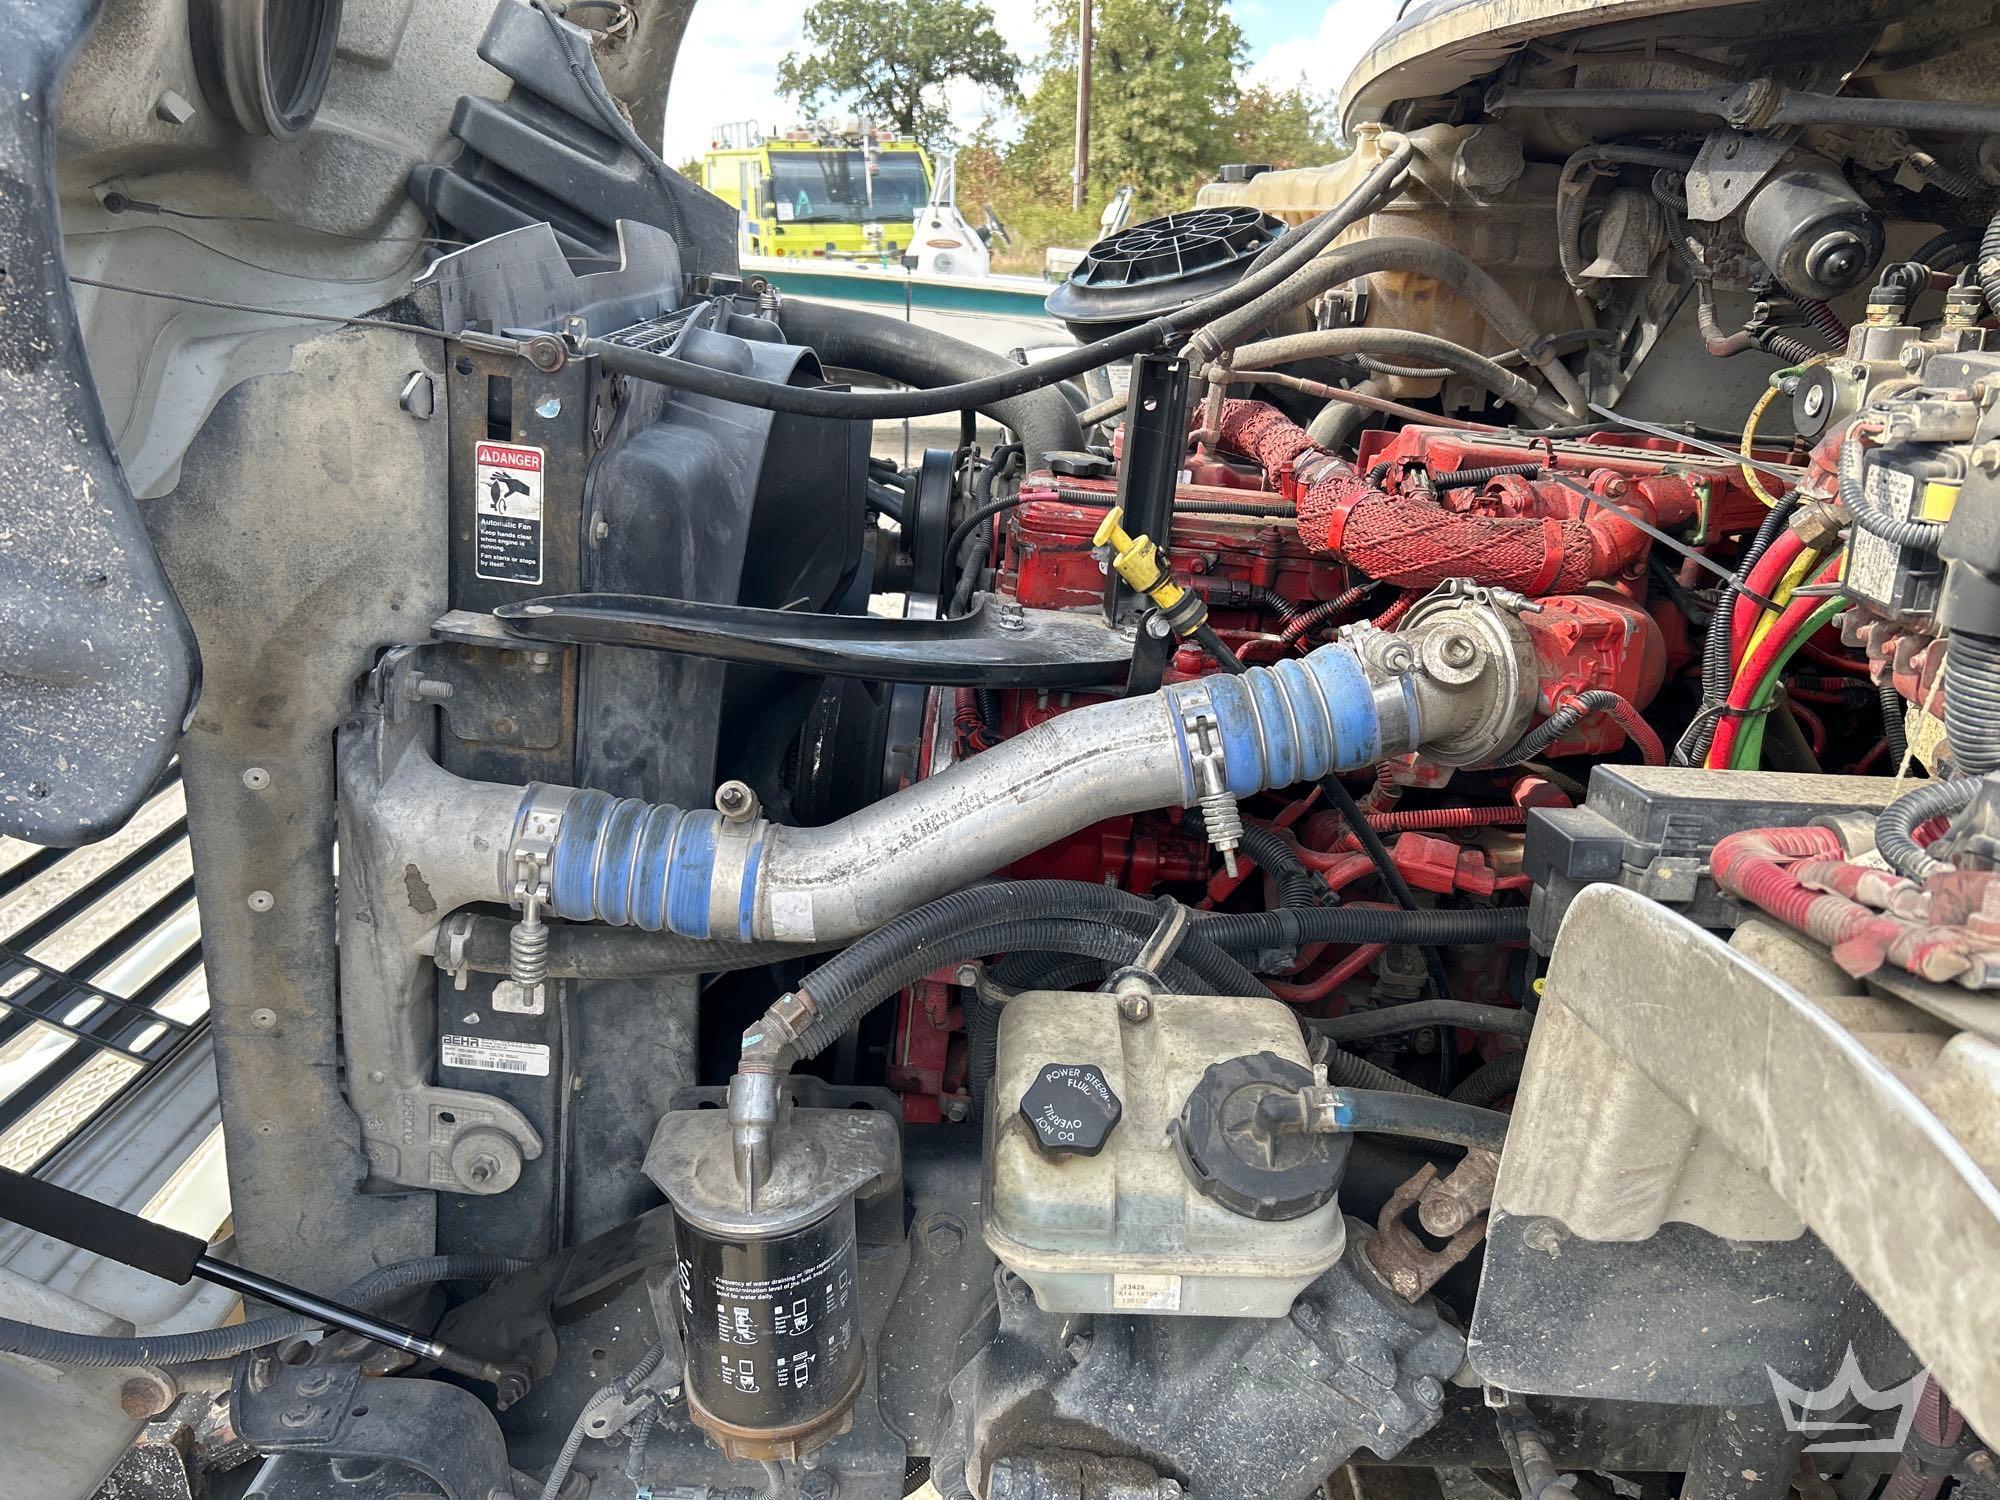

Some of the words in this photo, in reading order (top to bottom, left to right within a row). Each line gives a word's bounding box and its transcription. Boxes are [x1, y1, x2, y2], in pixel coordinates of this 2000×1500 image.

[492, 451, 539, 468] DANGER
[480, 518, 517, 529] Automatic
[518, 522, 532, 531] Fan
[480, 529, 497, 537] Keep
[497, 531, 516, 539] hands
[498, 538, 518, 546] engine
[480, 544, 505, 552] running.
[443, 1036, 479, 1047] BEHR
[1046, 1068, 1080, 1083] POWER
[1043, 1103, 1082, 1129] OVERFILL
[1036, 1116, 1054, 1134] NOT
[1058, 1132, 1075, 1141] DO
[716, 1276, 744, 1287] Frequency
[771, 1276, 795, 1285] draining
